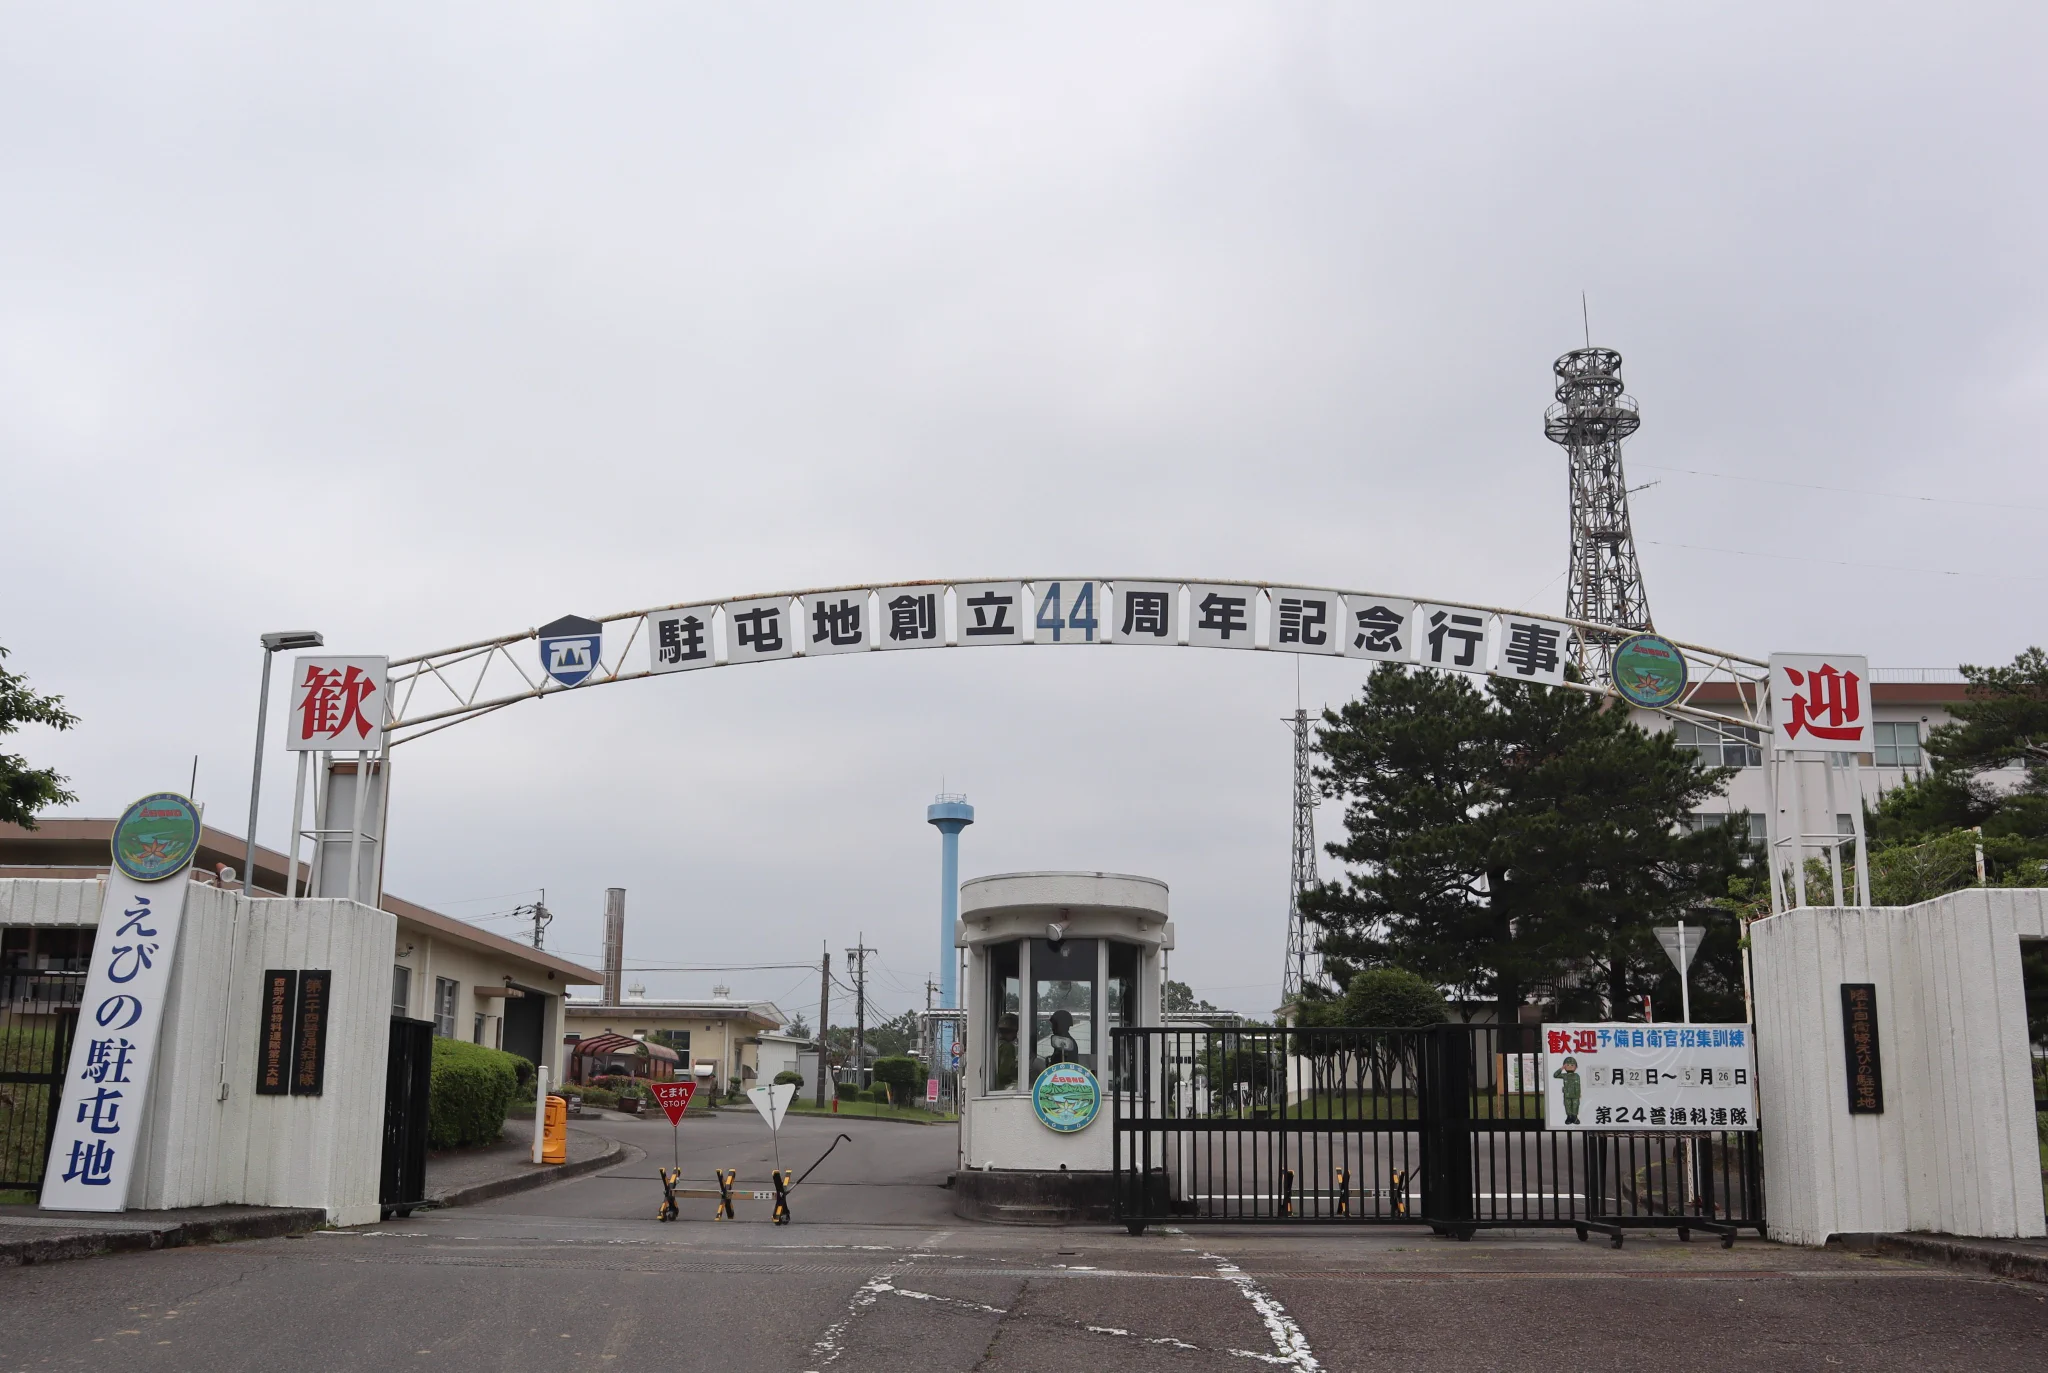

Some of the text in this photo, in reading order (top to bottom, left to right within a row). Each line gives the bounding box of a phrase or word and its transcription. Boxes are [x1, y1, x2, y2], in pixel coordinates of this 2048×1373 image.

[297, 664, 377, 741] 歓
[1782, 662, 1864, 741] 迎
[61, 895, 160, 1186] えびの駐屯地
[1547, 1029, 1745, 1054] 歓迎 予備自衛官招集訓練
[660, 1087, 689, 1098] とまれ
[663, 1100, 686, 1108] STOP
[1595, 1105, 1748, 1126] 第24普通科連隊
